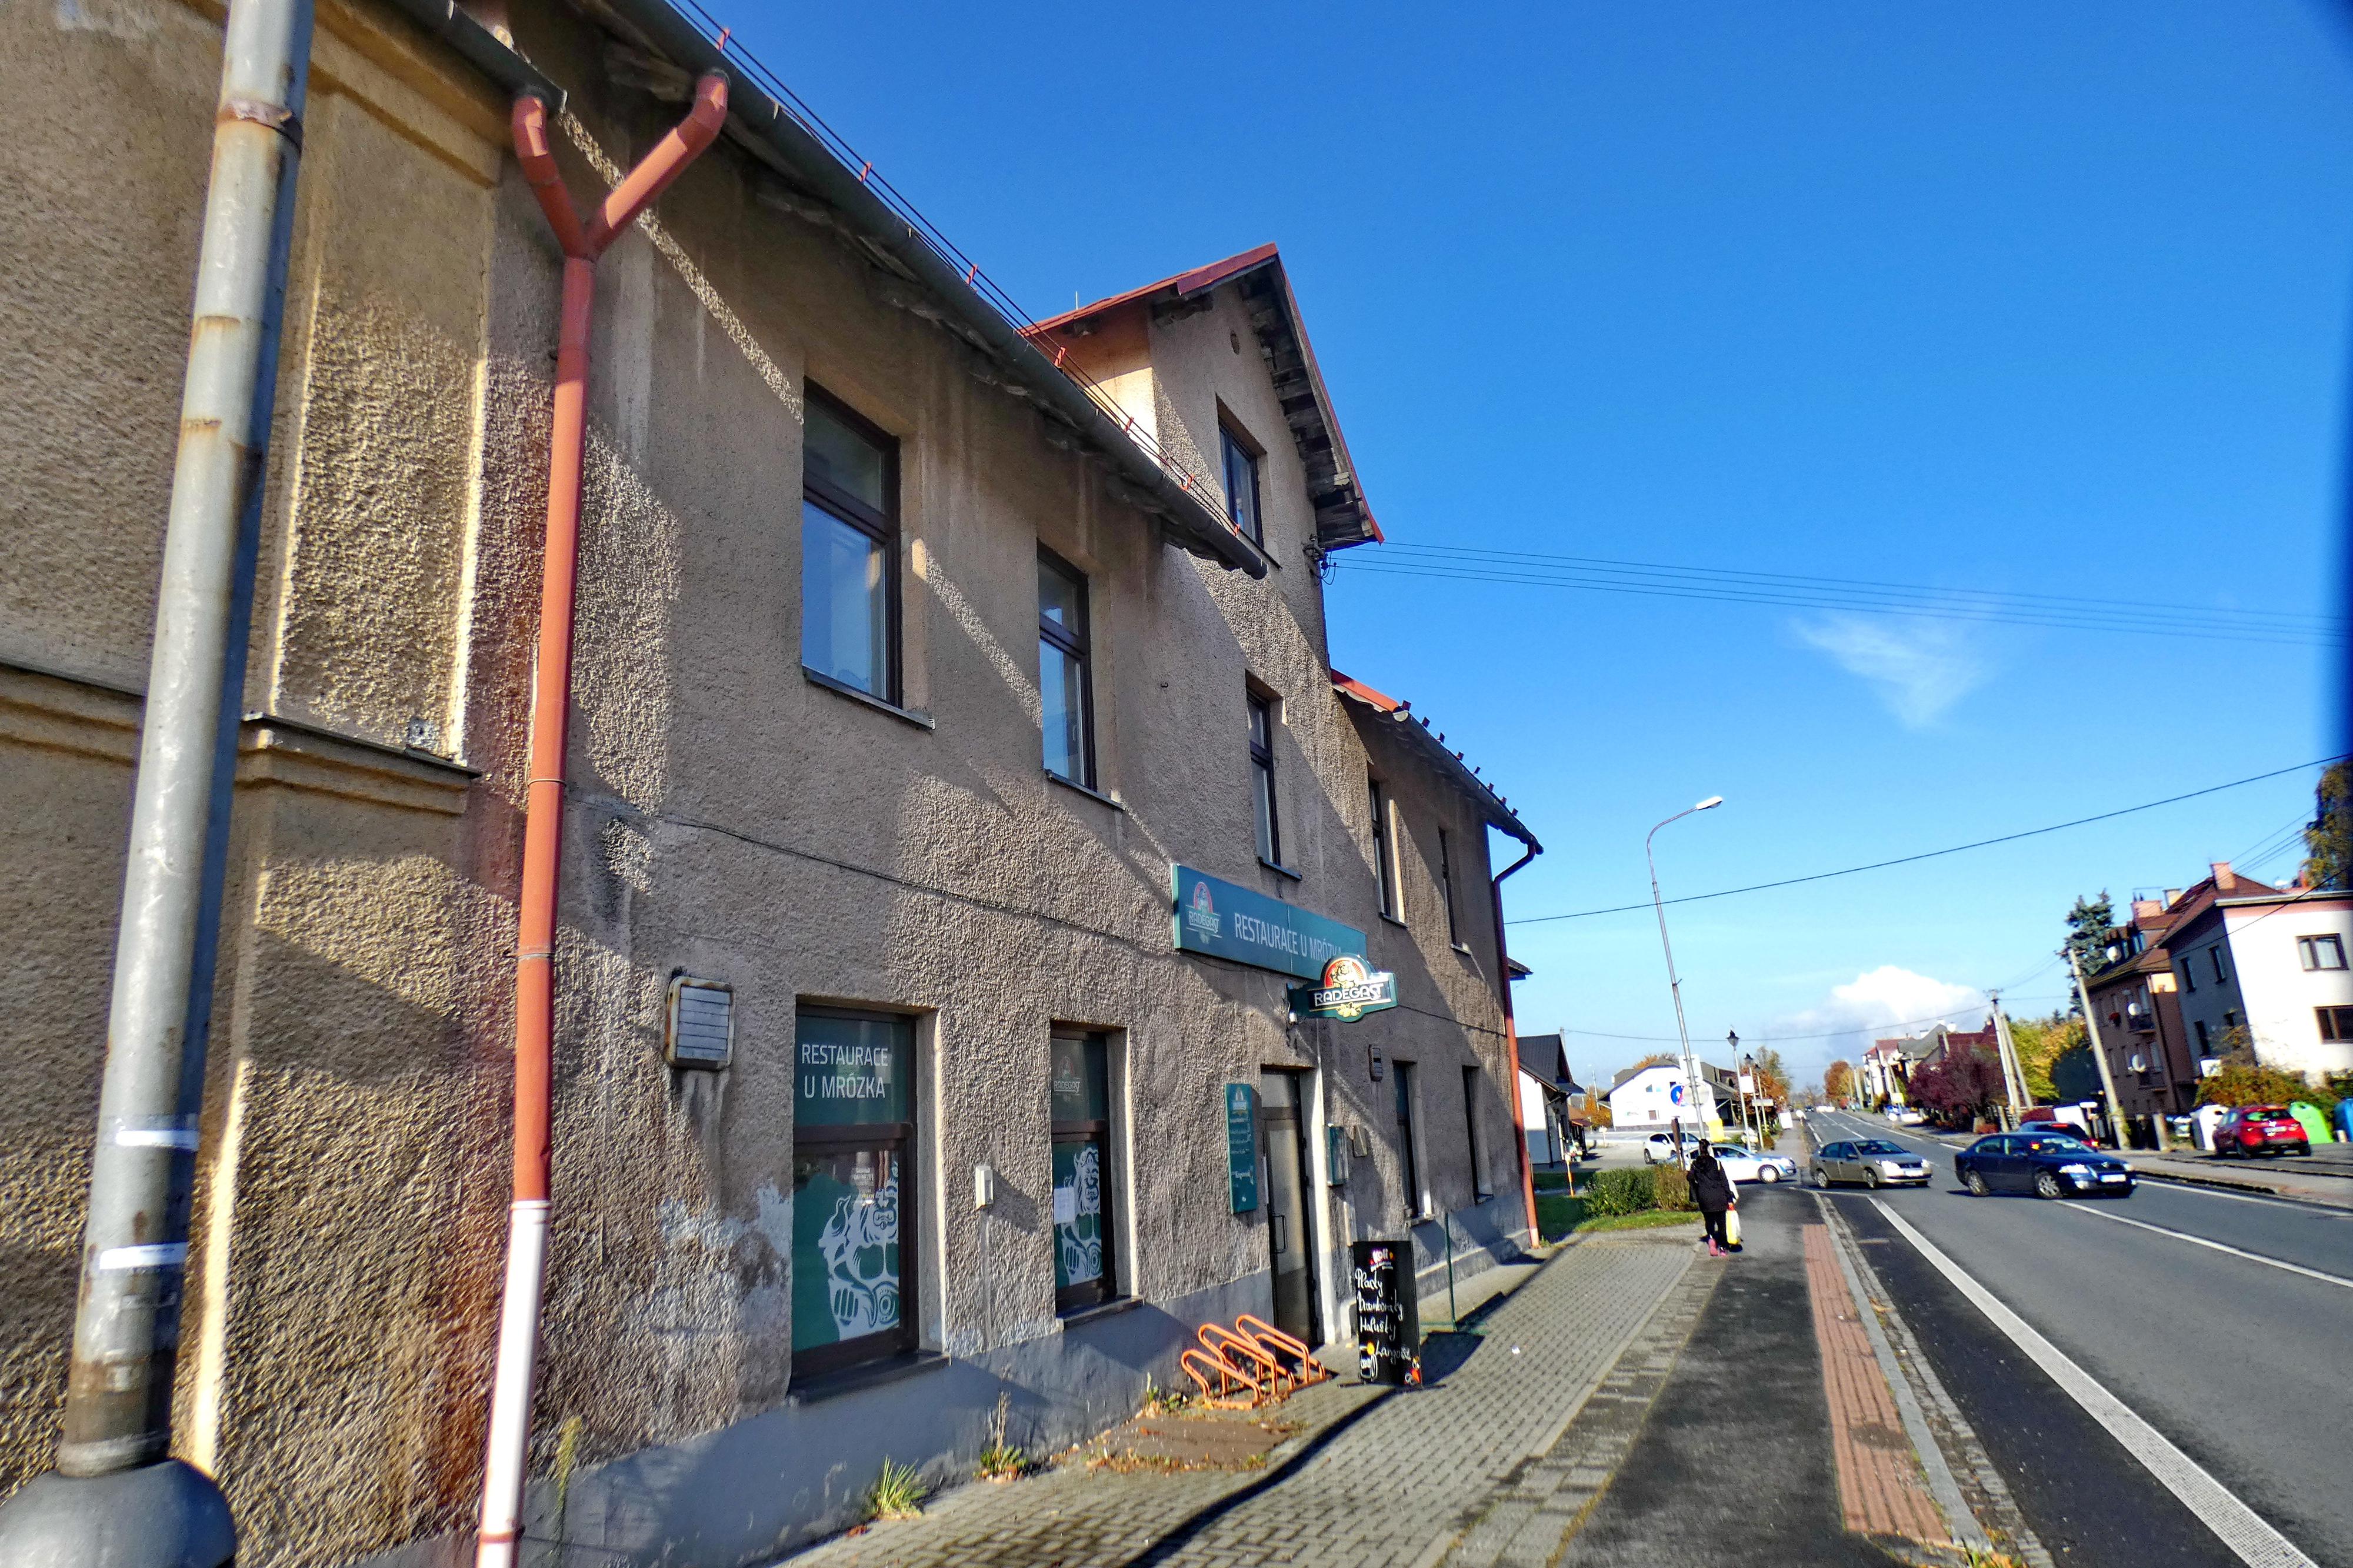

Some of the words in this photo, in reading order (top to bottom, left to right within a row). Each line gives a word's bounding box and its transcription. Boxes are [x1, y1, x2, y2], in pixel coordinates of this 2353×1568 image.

[1189, 911, 1219, 933] RADEGAST
[1235, 913, 1298, 955] RESTAURACE
[1301, 933, 1308, 957] U
[1314, 983, 1384, 1006] RADEGAST
[802, 1044, 888, 1066] RESTAURACE
[804, 1075, 815, 1098] U
[822, 1072, 886, 1099] MRÓZKA
[1360, 1315, 1396, 1341] Halušky
